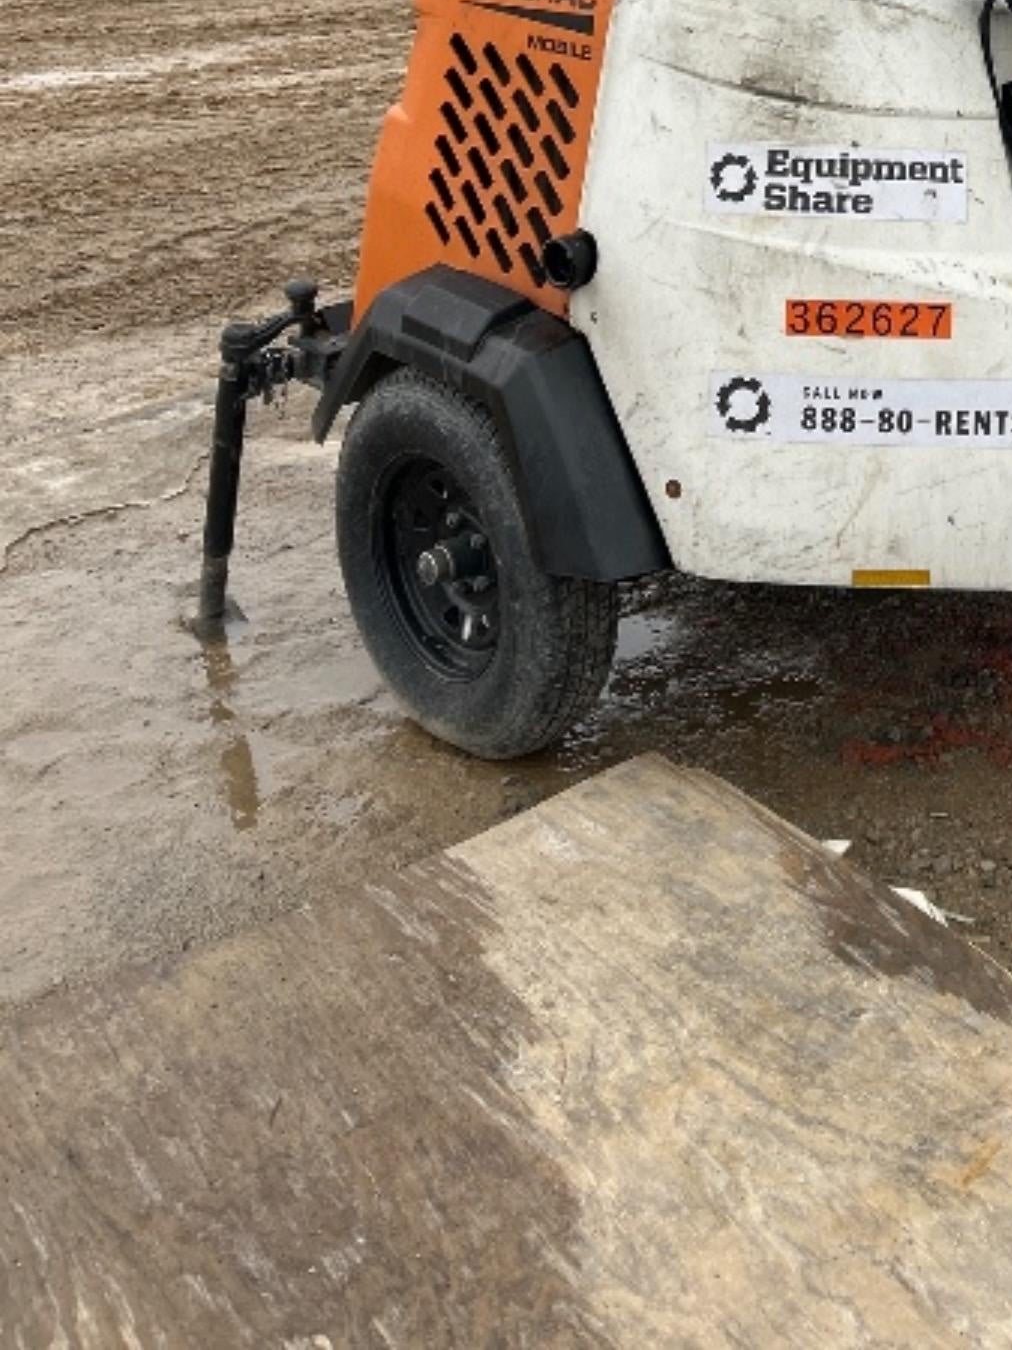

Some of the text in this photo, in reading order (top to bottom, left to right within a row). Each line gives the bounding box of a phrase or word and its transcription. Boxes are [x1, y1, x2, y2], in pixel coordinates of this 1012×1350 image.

[526, 33, 593, 61] MOBILE
[764, 149, 964, 187] Equipment
[763, 183, 874, 214] Share
[788, 301, 947, 337] 362627
